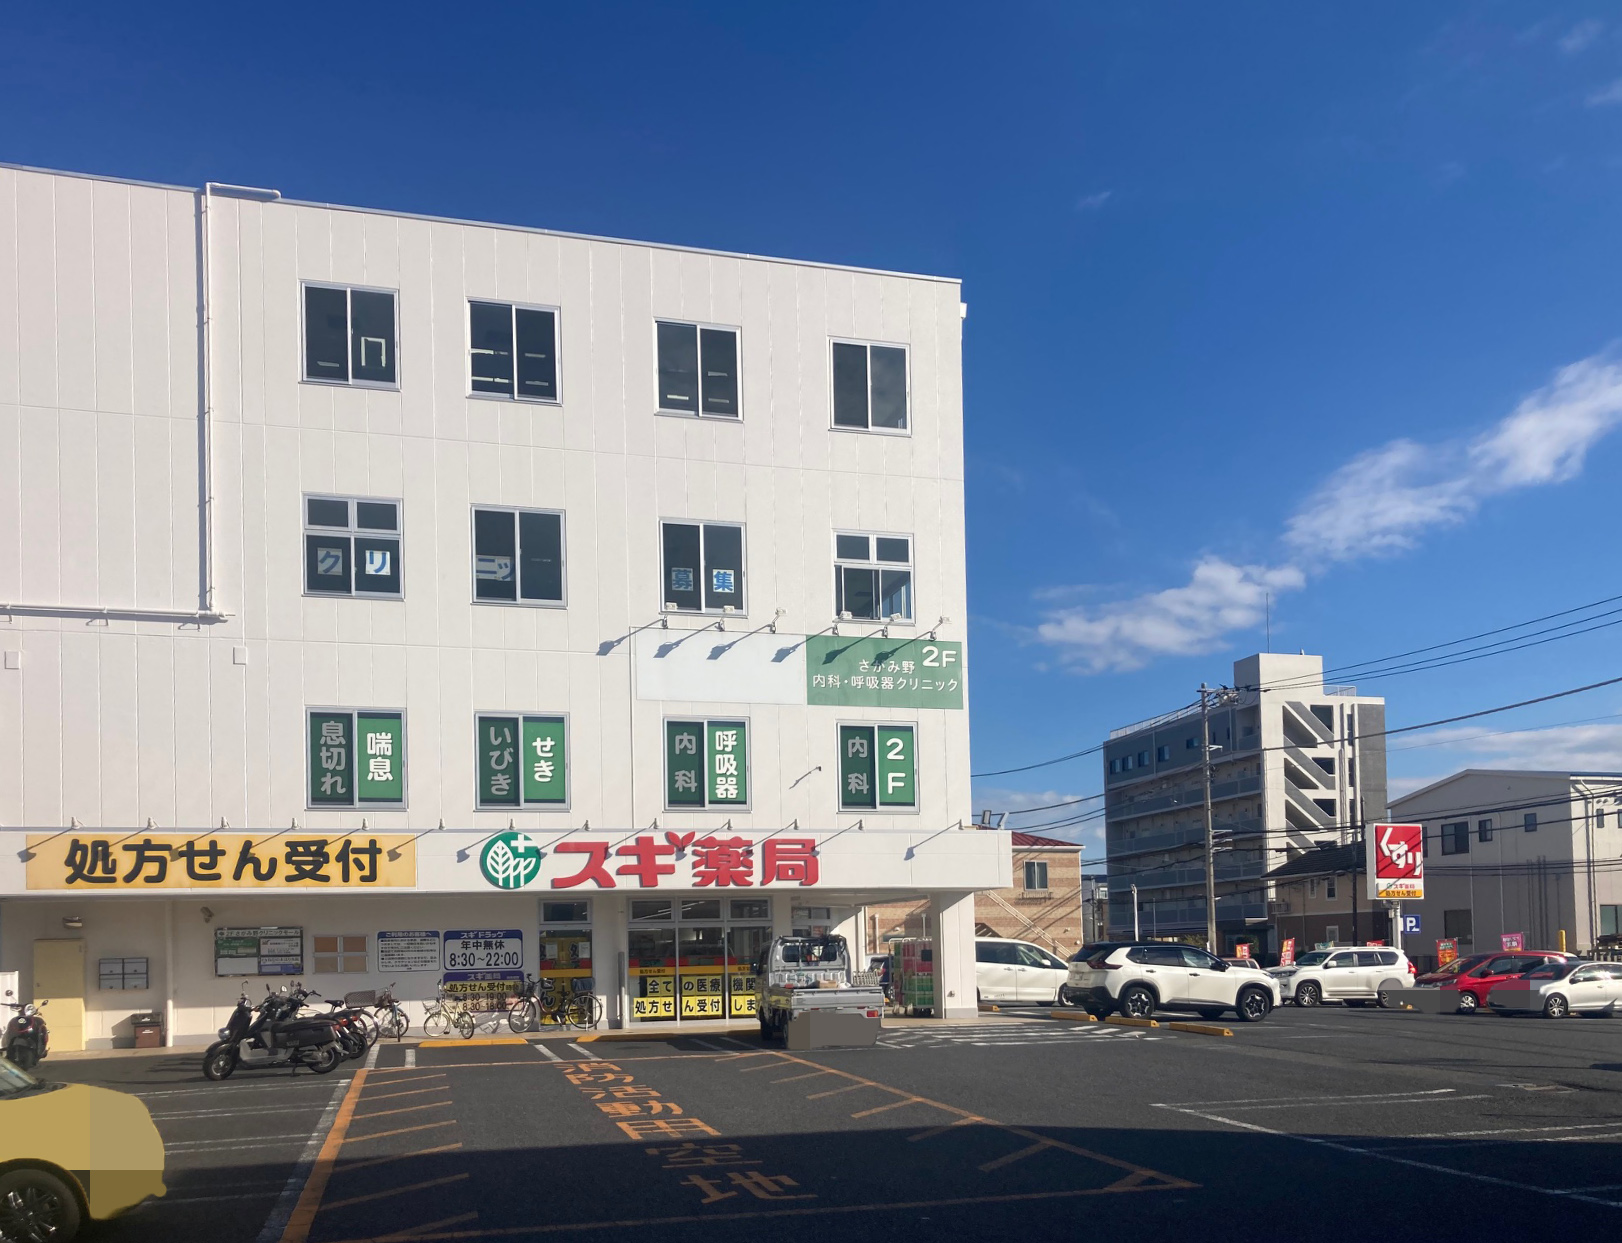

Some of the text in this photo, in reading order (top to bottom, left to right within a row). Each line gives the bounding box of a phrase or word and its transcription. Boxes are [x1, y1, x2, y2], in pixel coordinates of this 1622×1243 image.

[858, 659, 915, 674] さがみ野
[921, 645, 957, 668] 2F
[812, 674, 958, 692] 内科・呼吸器クリニック
[319, 721, 346, 795] 息切れ
[366, 731, 393, 781] 喘息
[489, 726, 513, 796] いびき
[531, 736, 555, 782] せき
[674, 732, 698, 793] 内科
[714, 730, 739, 799] 呼吸器
[847, 736, 869, 795] 内科
[885, 737, 906, 794] 2F
[64, 838, 383, 884] 処方せん受付
[551, 833, 820, 888] スギ薬局
[1380, 827, 1423, 876] くすり
[461, 940, 505, 950] 年中無休
